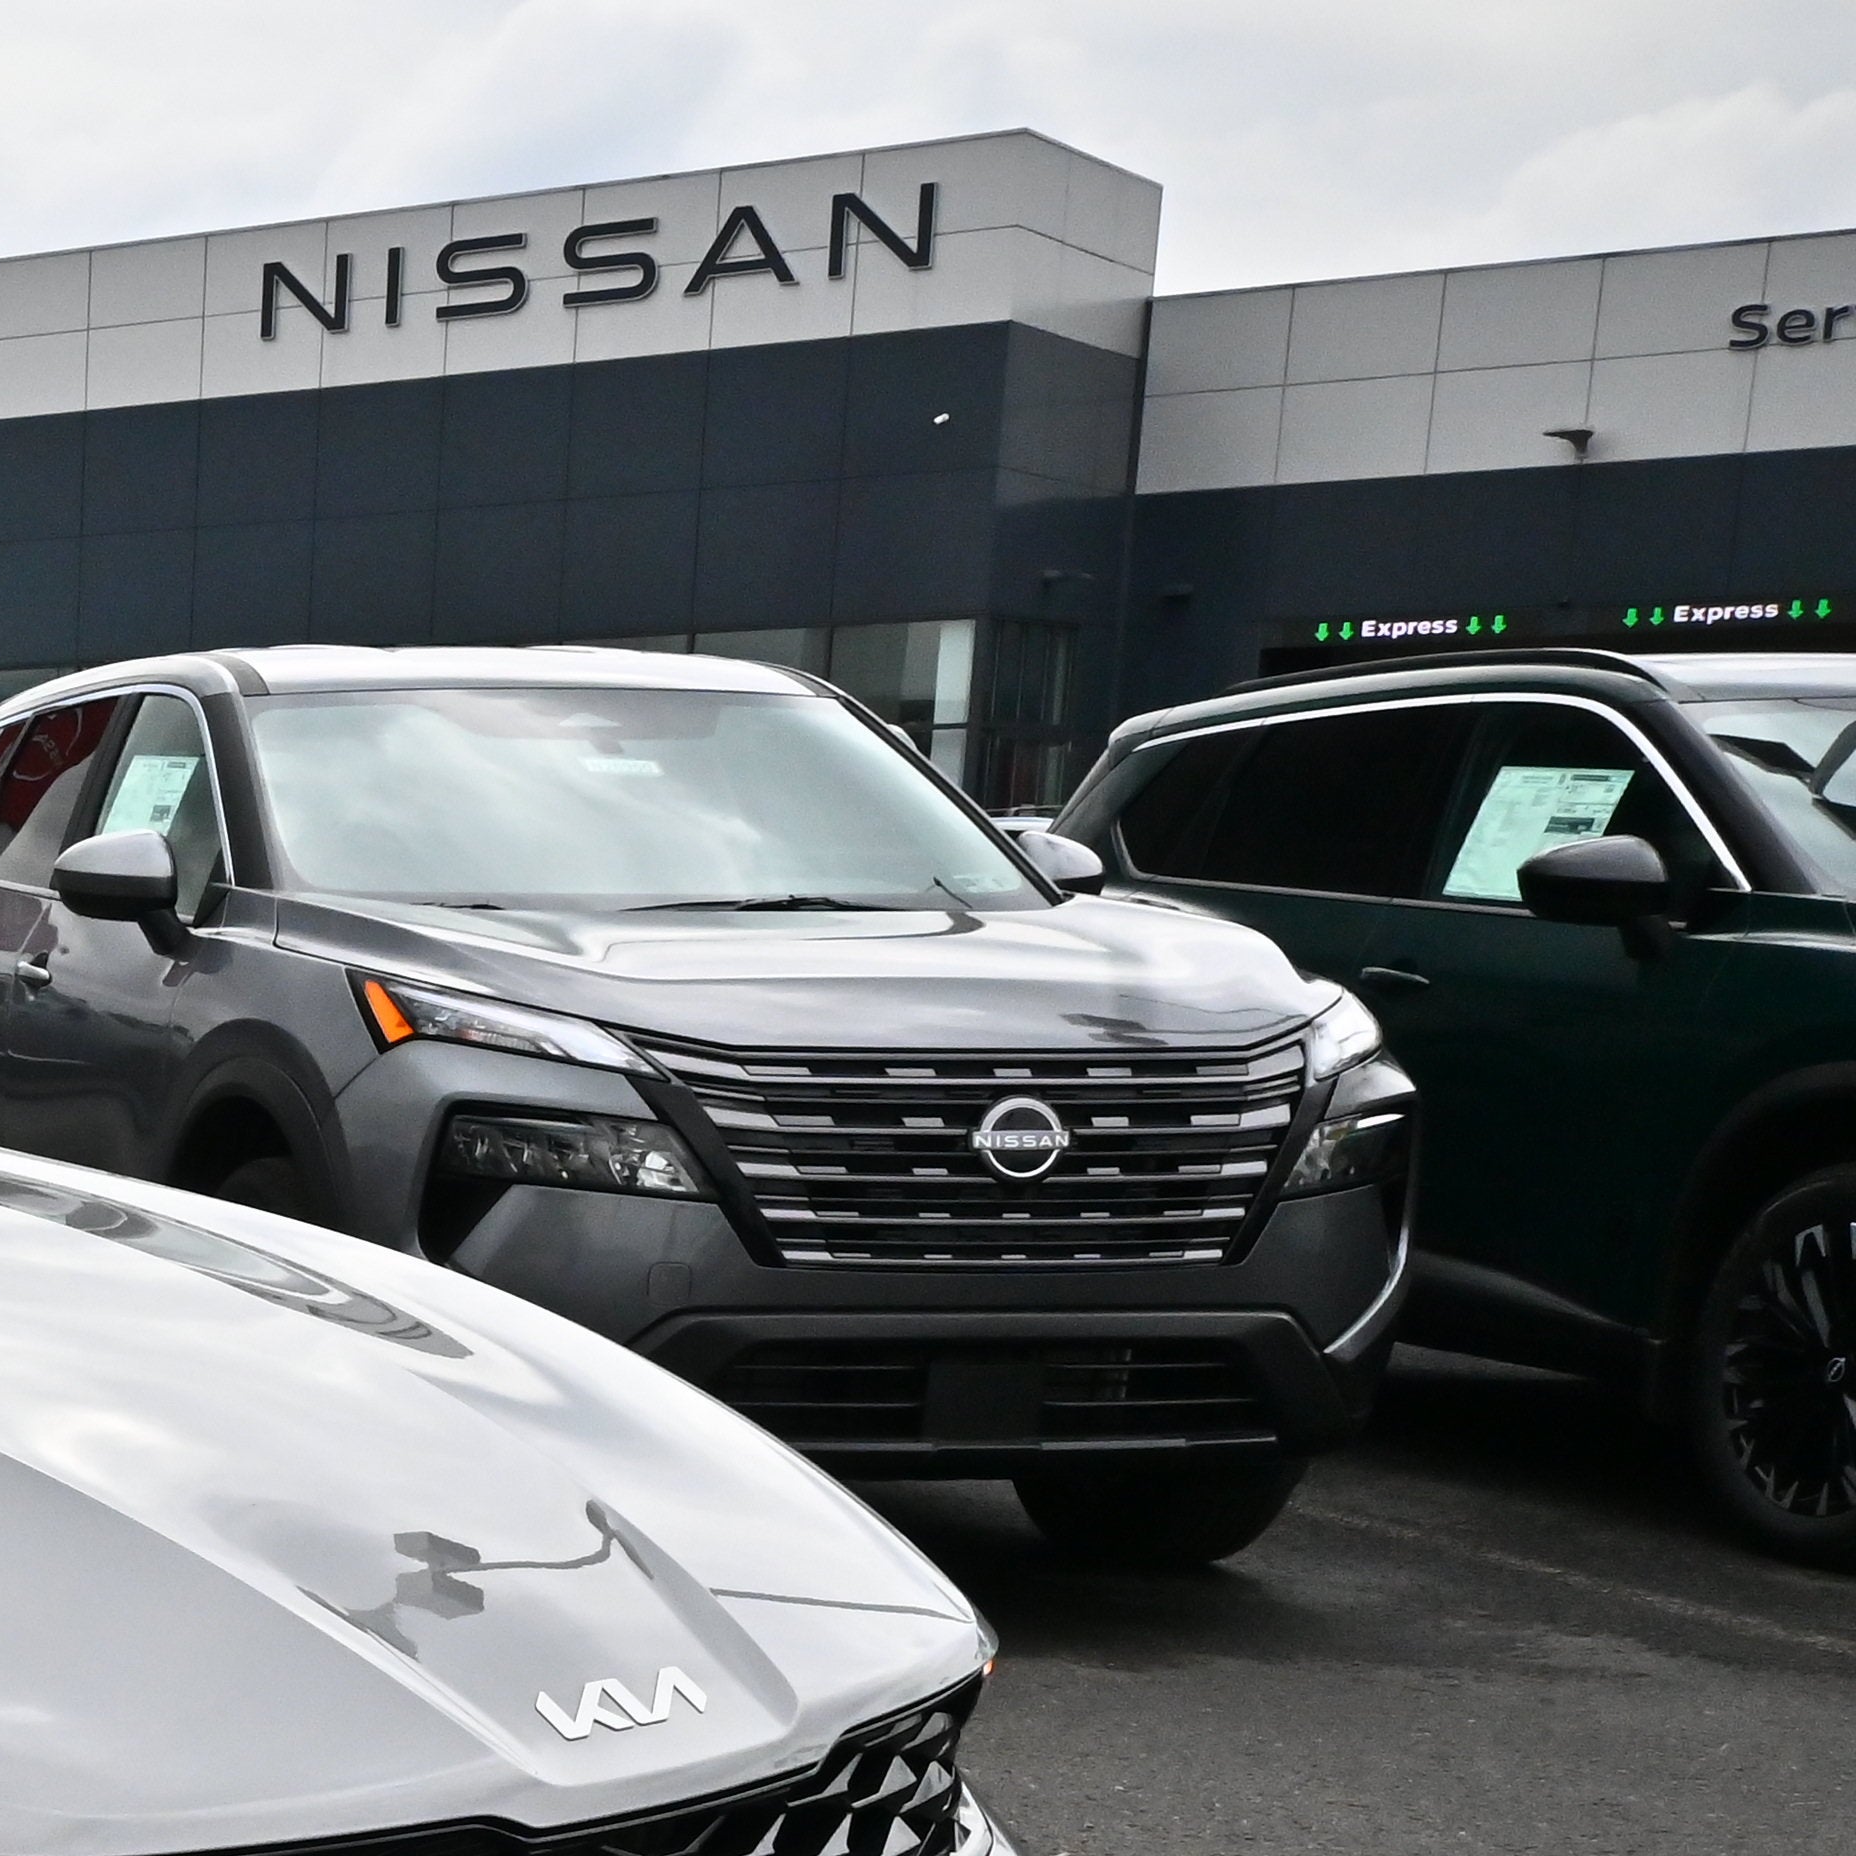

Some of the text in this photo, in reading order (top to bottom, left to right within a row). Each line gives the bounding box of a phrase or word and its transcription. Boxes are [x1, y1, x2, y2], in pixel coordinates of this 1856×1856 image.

[261, 182, 938, 340] NISSAN
[1729, 304, 1856, 351] Ser
[1361, 619, 1458, 640] Express
[1672, 603, 1779, 625] Express
[975, 1134, 1069, 1148] NISSAN
[535, 1665, 707, 1741] KIA
